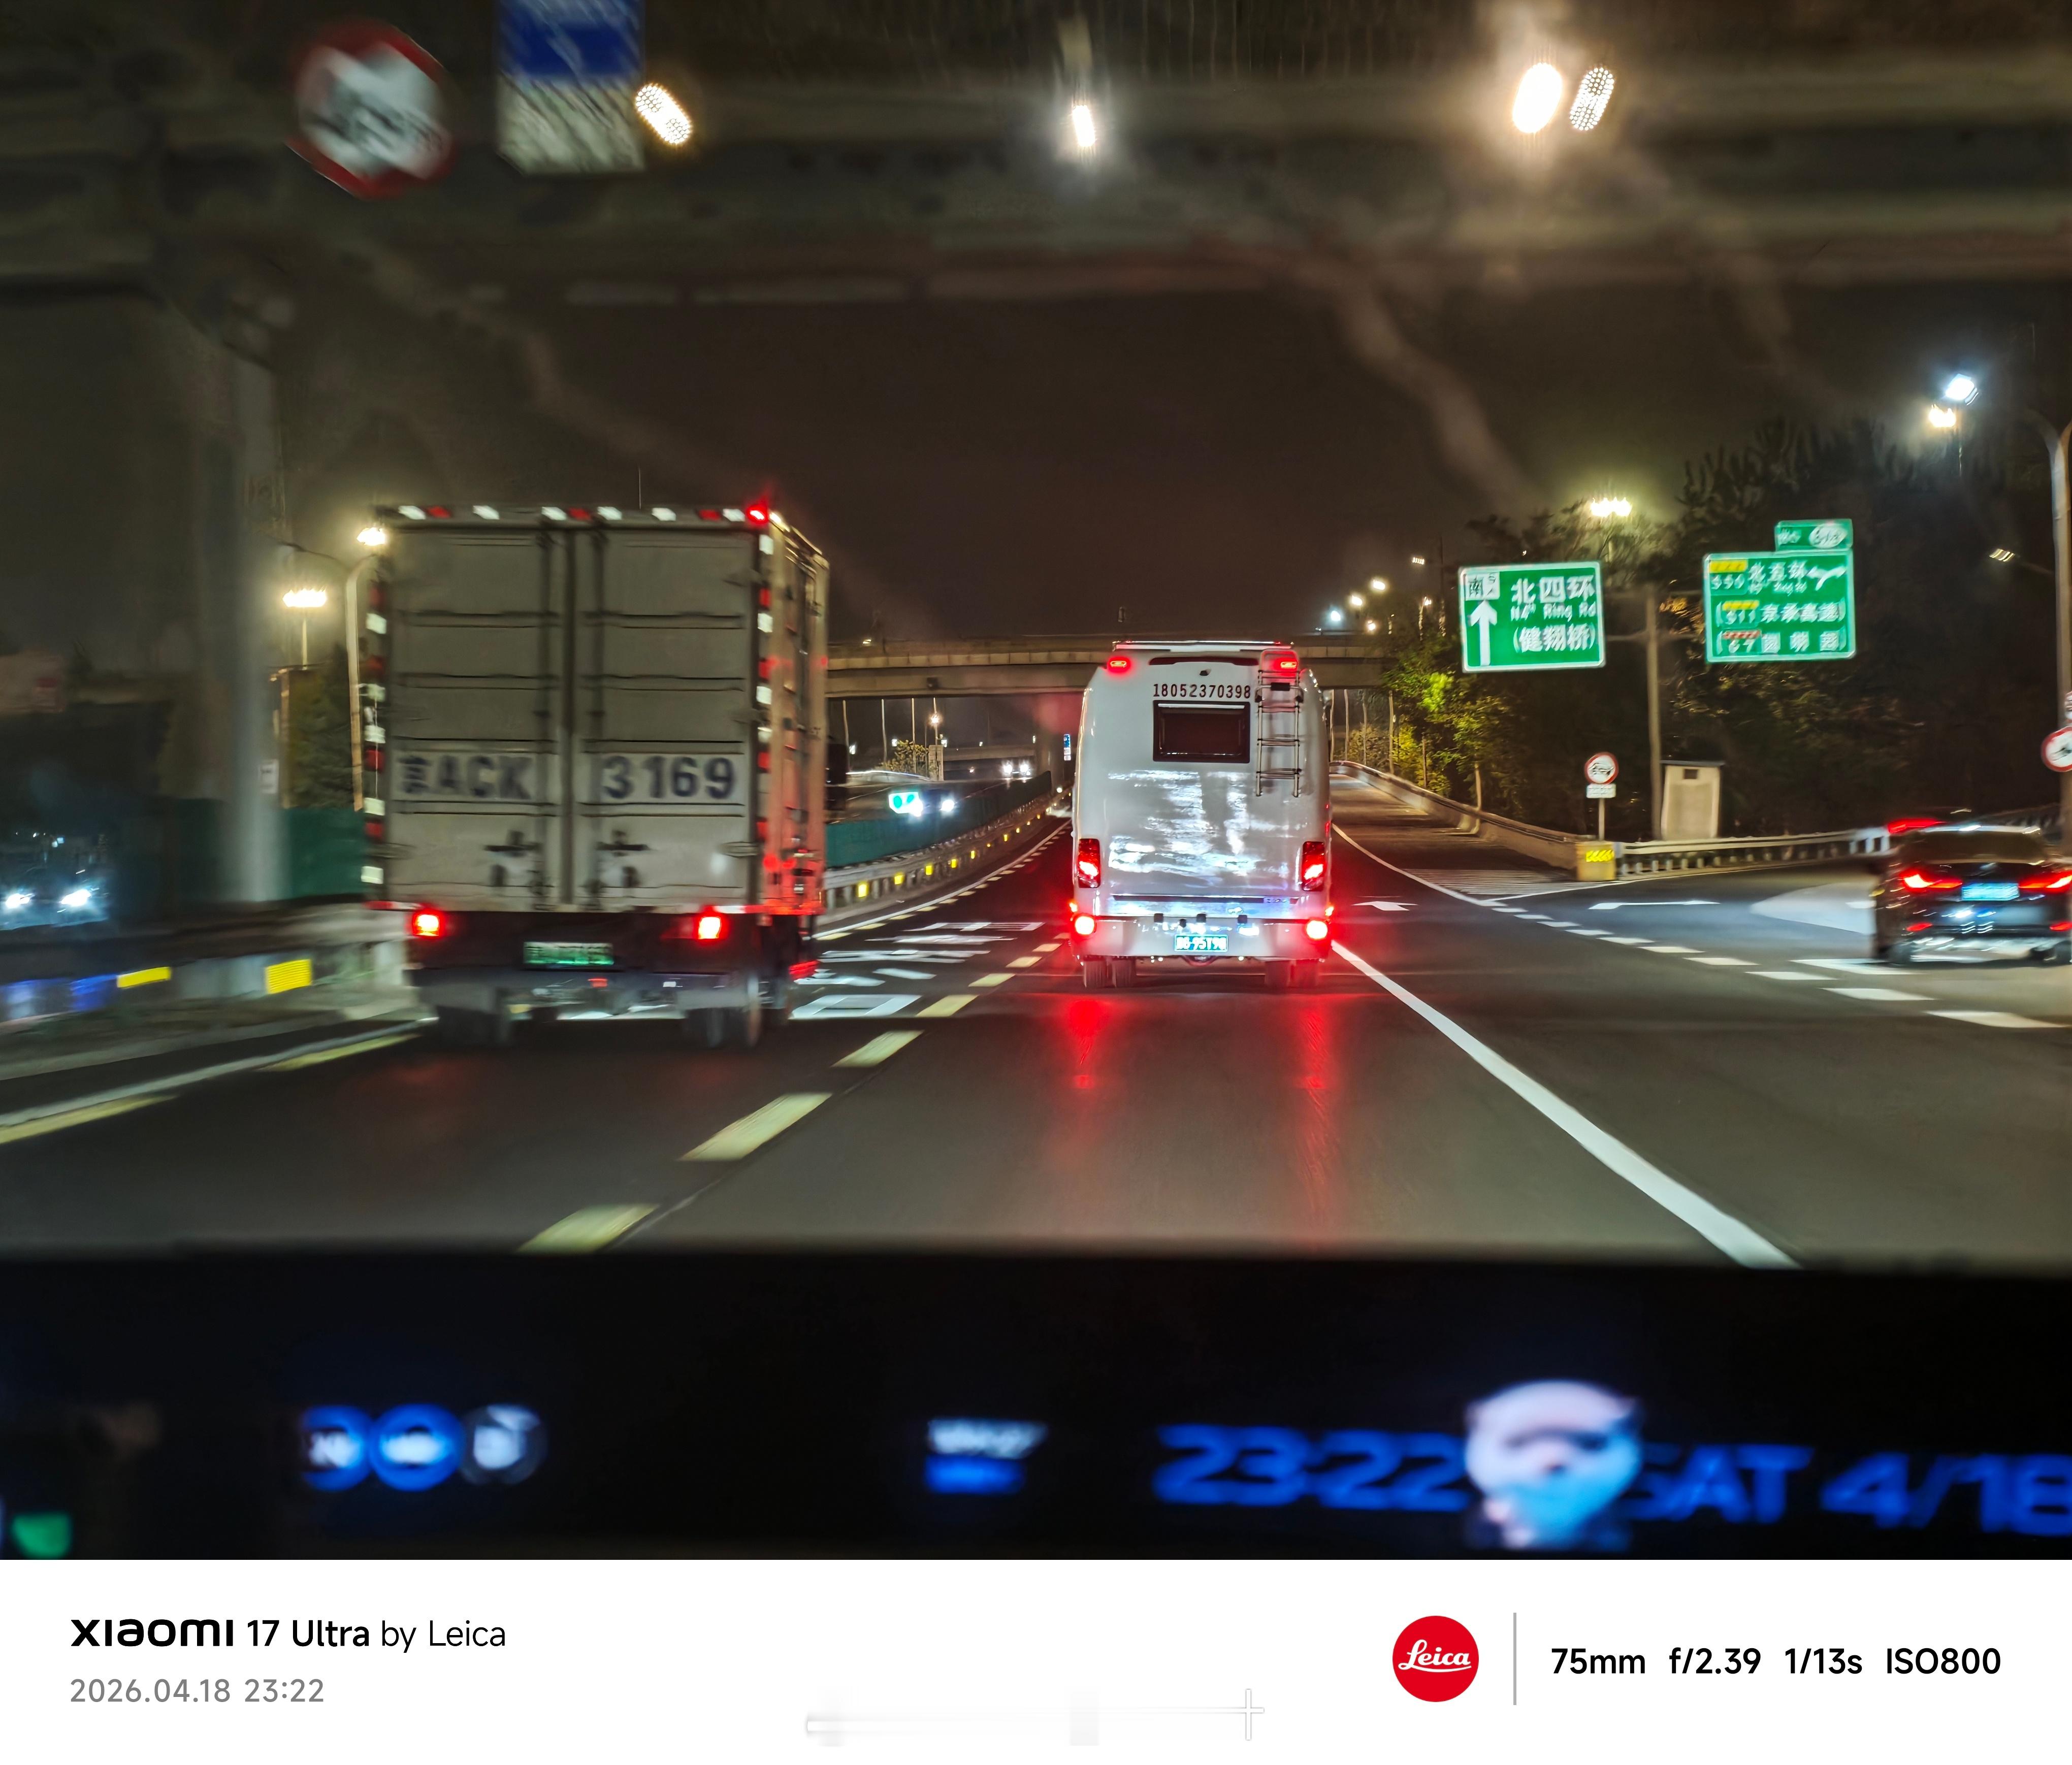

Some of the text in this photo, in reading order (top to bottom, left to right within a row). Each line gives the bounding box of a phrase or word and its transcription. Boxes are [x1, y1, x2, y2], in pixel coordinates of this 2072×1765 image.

[1510, 575, 1595, 605] 北四环
[1153, 683, 1251, 699] 18052370398
[601, 756, 736, 800] 3169
